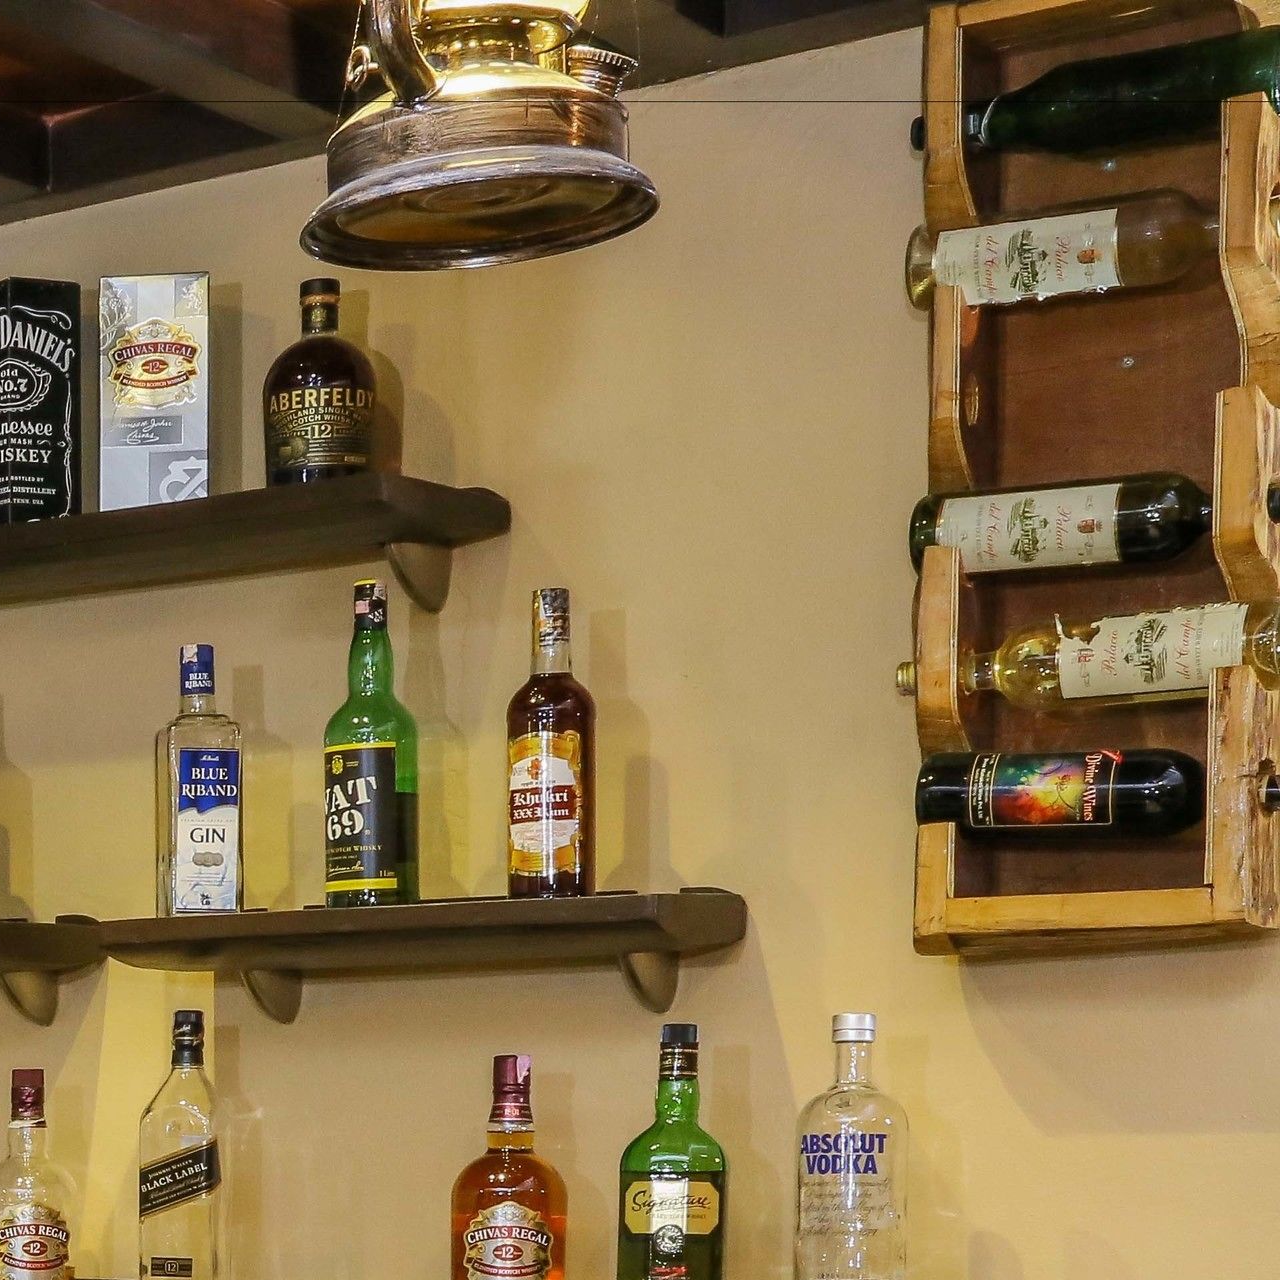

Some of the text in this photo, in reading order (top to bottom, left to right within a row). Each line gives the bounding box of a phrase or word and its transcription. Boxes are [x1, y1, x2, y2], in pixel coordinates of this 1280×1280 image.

[0, 315, 75, 372] DANIEL'S
[114, 343, 194, 361] CHIVAS REGAL
[148, 361, 160, 372] 12
[270, 388, 374, 414] ABERFELDY
[311, 424, 332, 439] 12
[12, 486, 57, 495] DISTILLERY
[189, 673, 209, 681] BLUE
[1176, 661, 1190, 681] del
[185, 680, 213, 690] RIBAND
[191, 767, 228, 781] BLUE
[181, 783, 237, 800] RIBAND
[1081, 753, 1103, 821] Divine Wines
[327, 809, 365, 840] 69
[190, 828, 225, 843] GIN
[800, 1134, 887, 1154] ABSOLUT
[806, 1155, 878, 1174] VODKA
[141, 1163, 208, 1192] BLACK LABEL
[631, 1190, 712, 1215] Signature
[38, 1225, 67, 1241] REGAL
[468, 1226, 548, 1246] CHIVAS REGAL
[30, 1243, 40, 1253] 12
[501, 1246, 514, 1258] 12
[167, 1263, 177, 1272] 12
